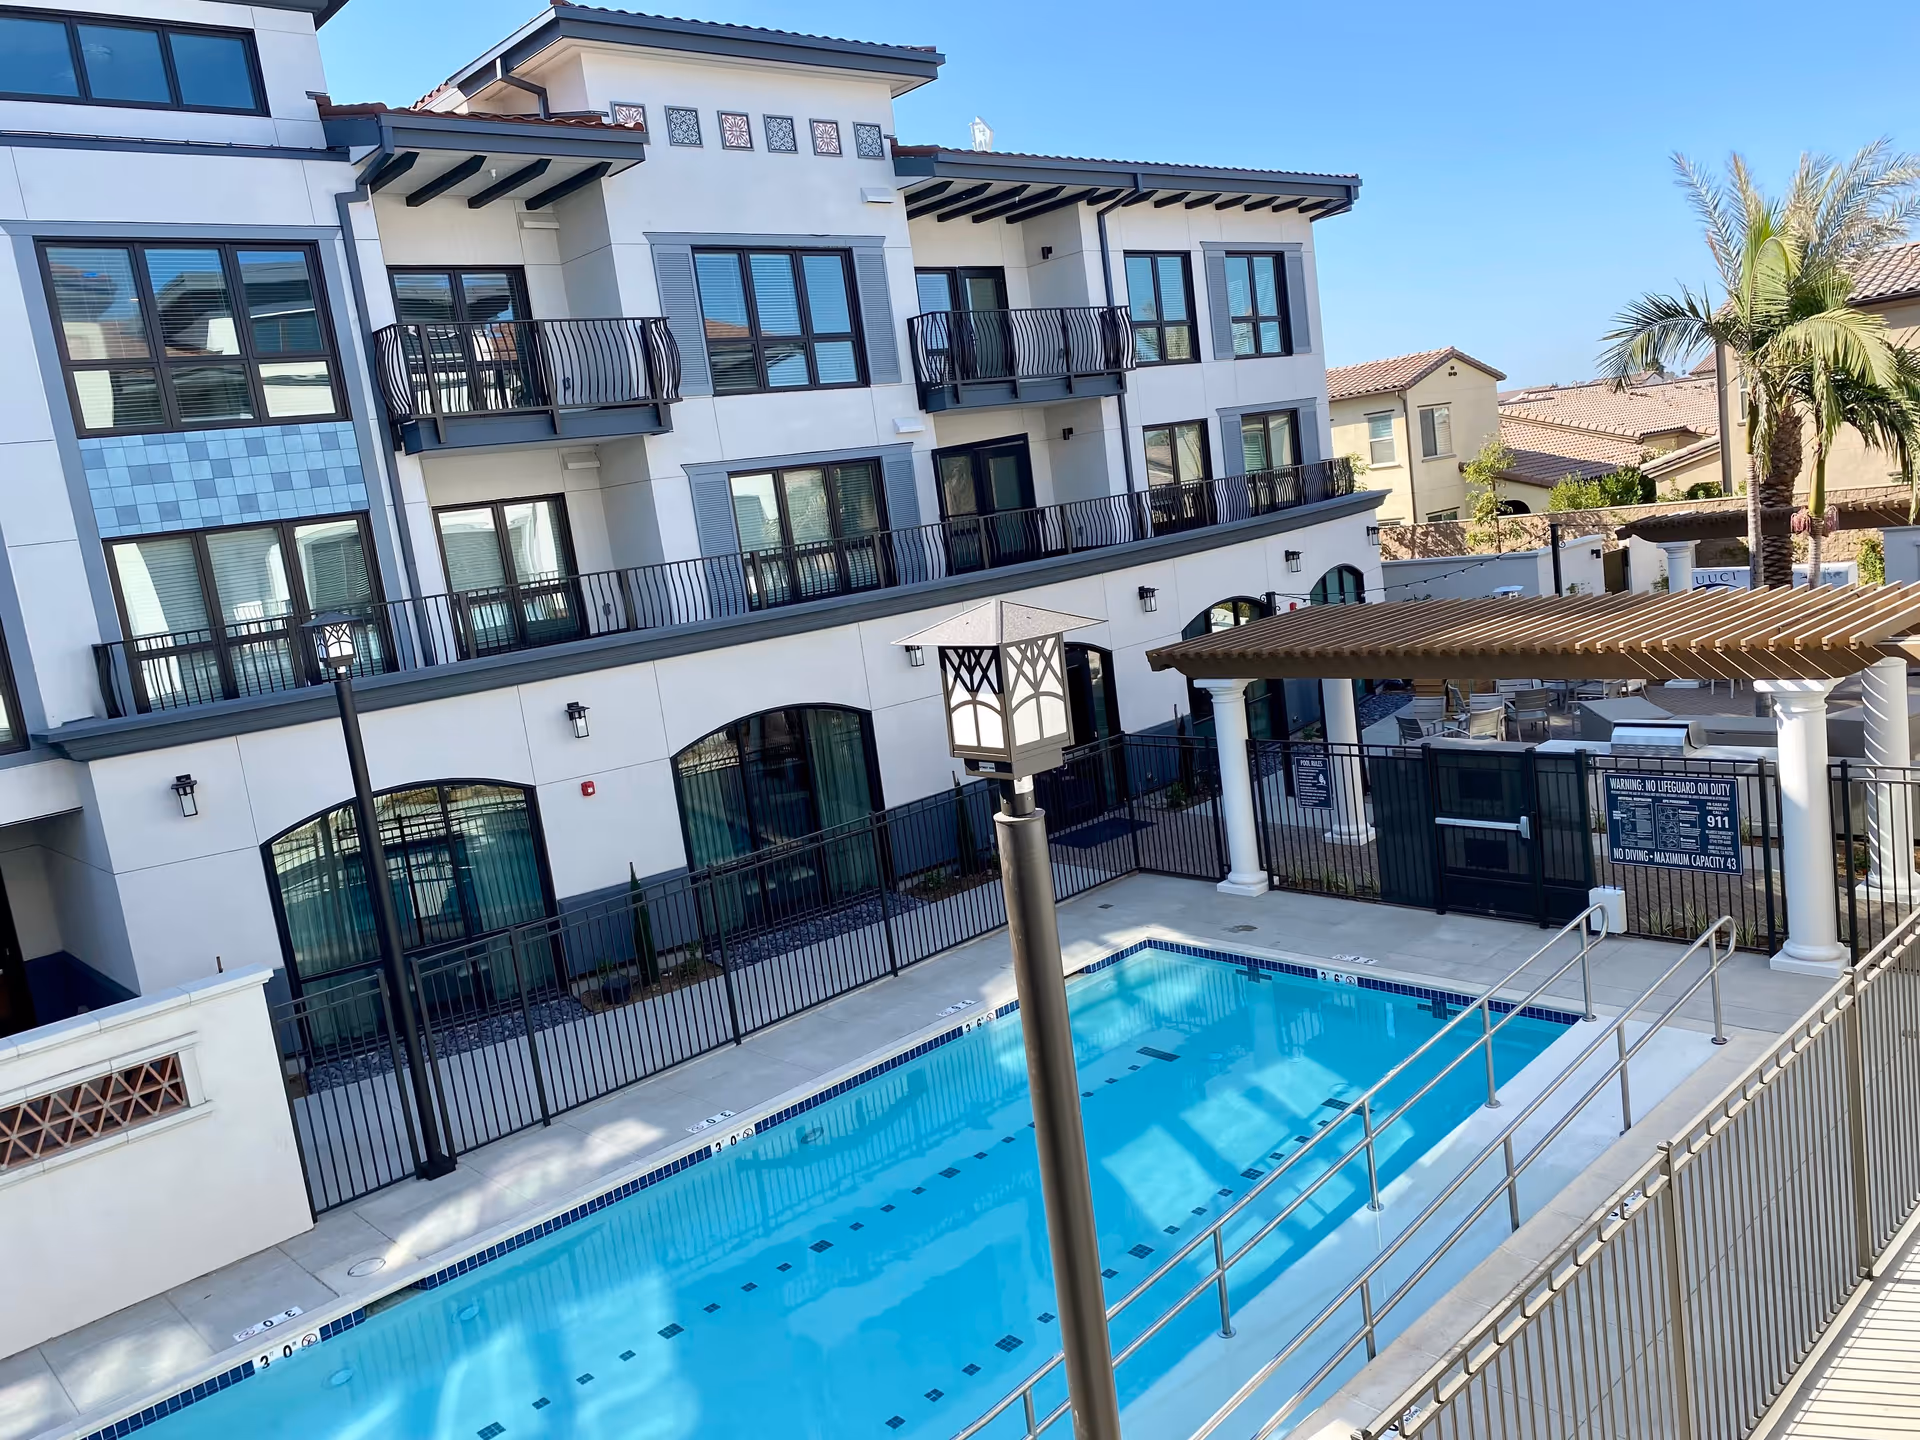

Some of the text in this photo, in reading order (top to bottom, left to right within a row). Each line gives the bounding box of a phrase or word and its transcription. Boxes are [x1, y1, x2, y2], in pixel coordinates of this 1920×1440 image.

[1609, 778, 1644, 791] WARNING:
[1645, 780, 1656, 792] NO
[1658, 780, 1696, 794] LIFEGUARD
[1698, 782, 1709, 795] ON
[1711, 783, 1731, 796] DUTY
[1707, 815, 1729, 829] 911
[1613, 847, 1737, 870] NO DIVING MAXIMUM CAPACITY 43
